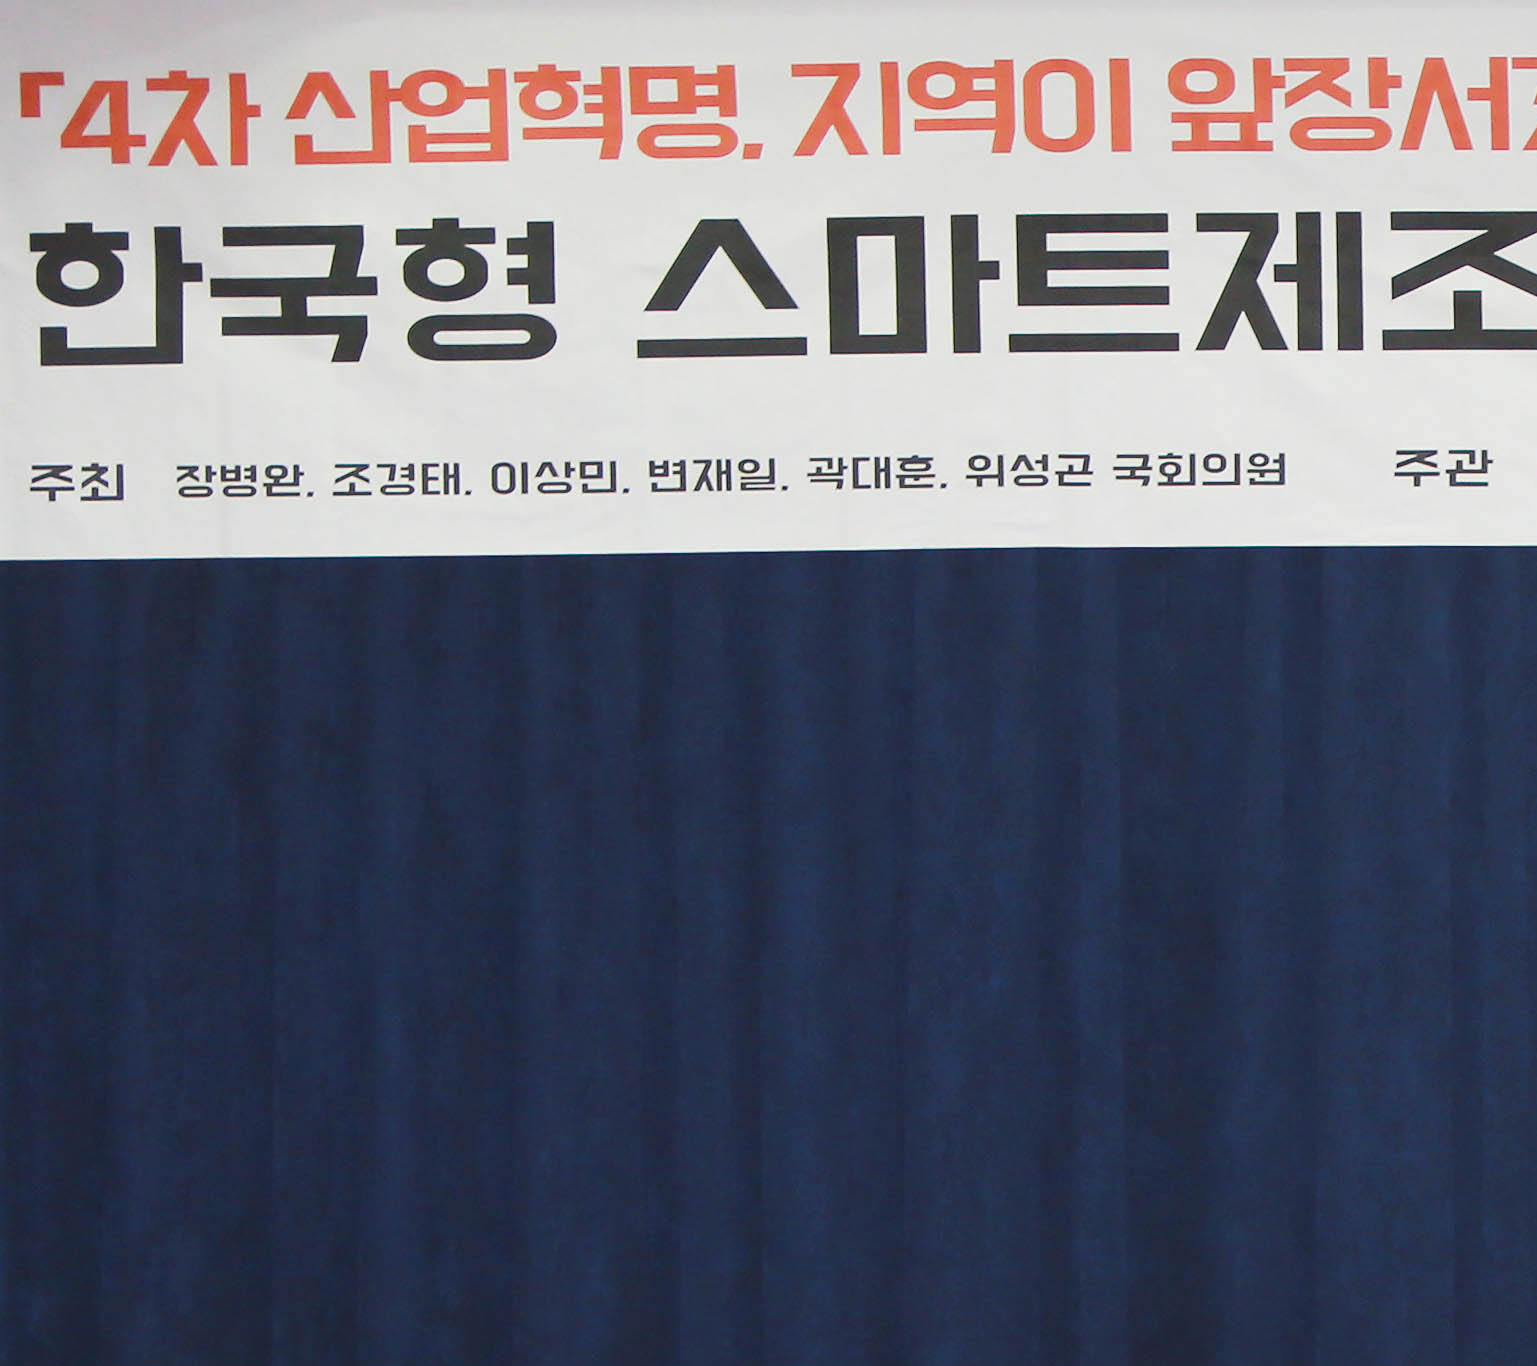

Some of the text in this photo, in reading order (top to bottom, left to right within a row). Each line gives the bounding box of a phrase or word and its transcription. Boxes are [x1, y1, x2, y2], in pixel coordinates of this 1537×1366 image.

[18, 69, 262, 167] 「4차
[790, 57, 1133, 157] 지역이
[28, 216, 558, 367] 한국형
[29, 462, 125, 502] 주최
[965, 453, 1094, 488] 위성곤
[1112, 452, 1286, 487] 국회의원
[1393, 449, 1494, 488] 주관
